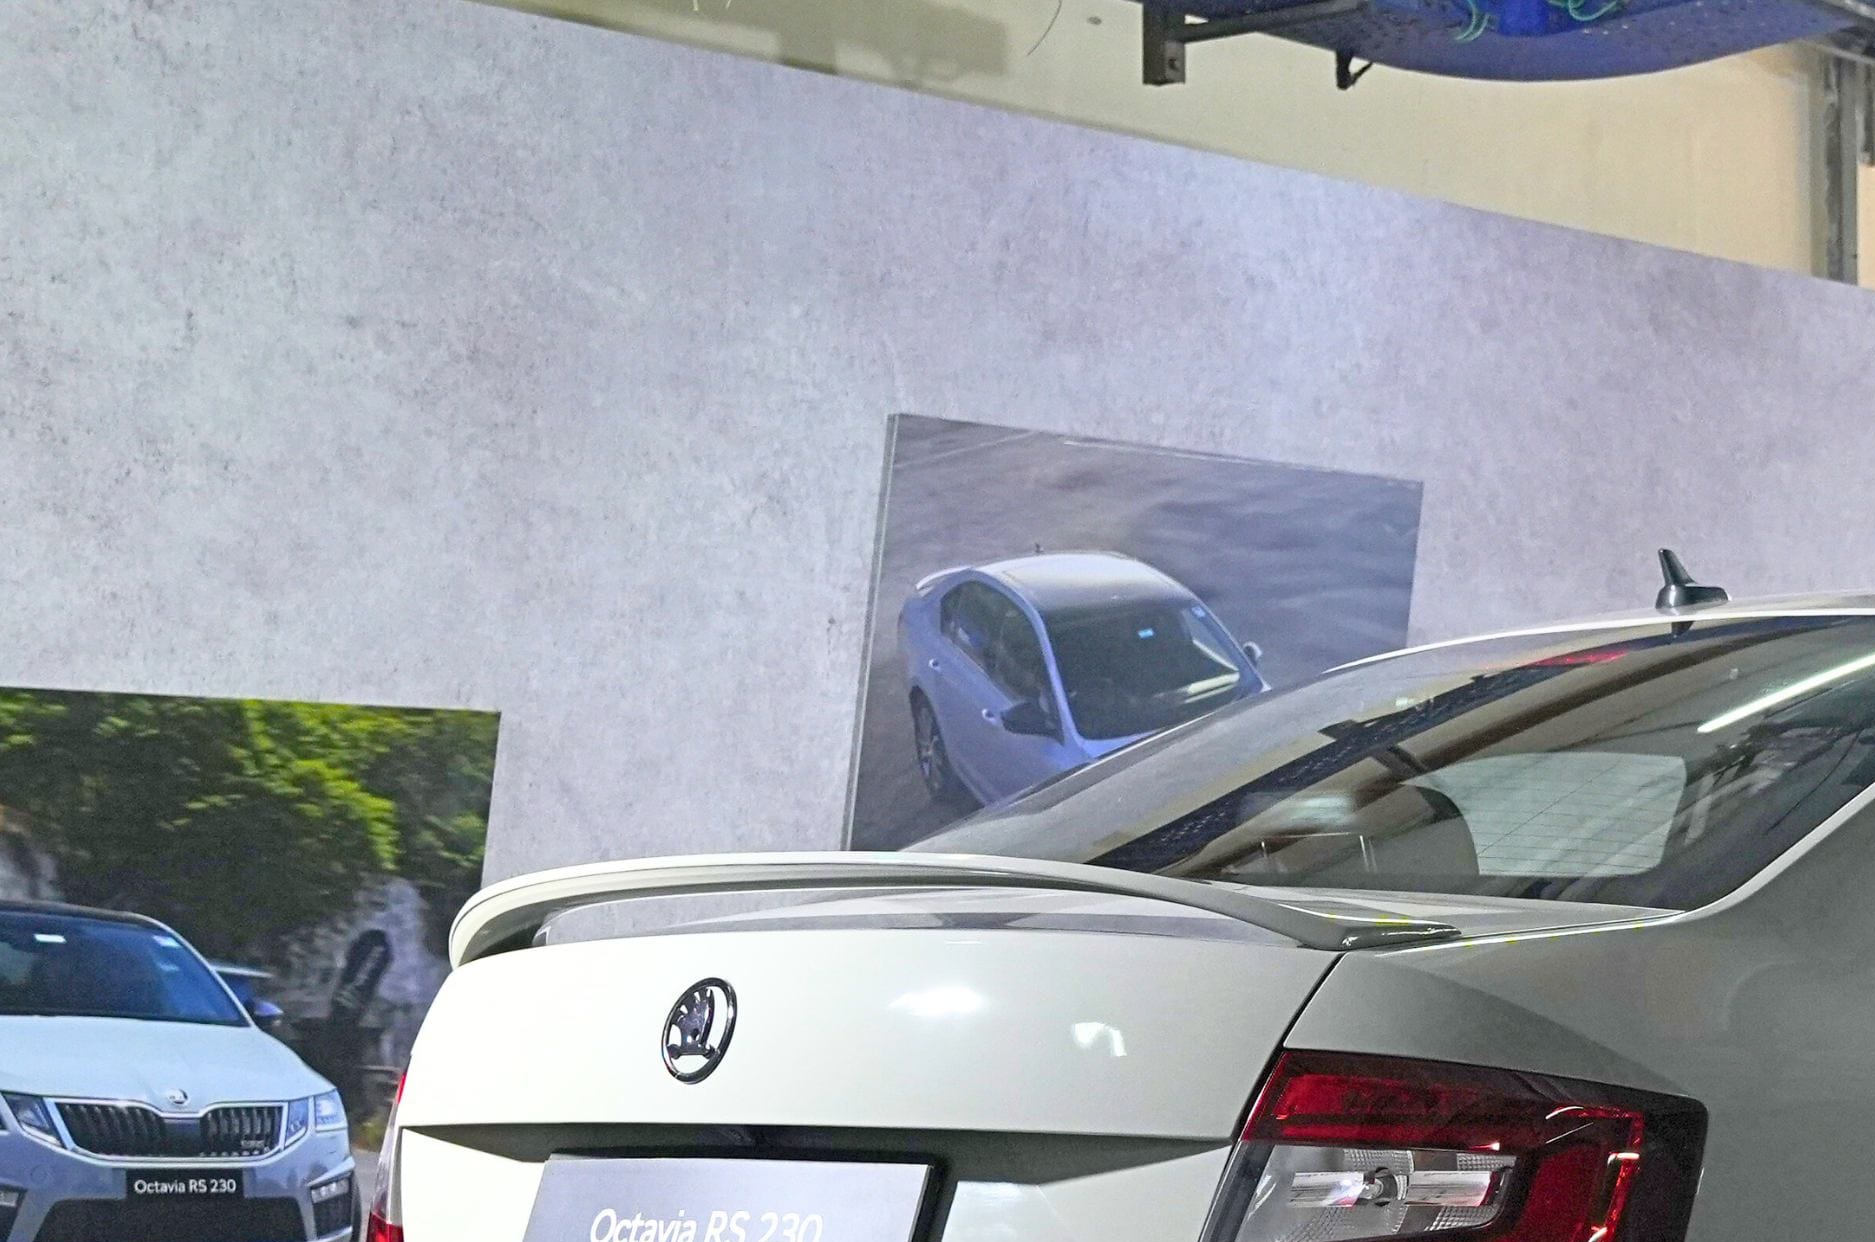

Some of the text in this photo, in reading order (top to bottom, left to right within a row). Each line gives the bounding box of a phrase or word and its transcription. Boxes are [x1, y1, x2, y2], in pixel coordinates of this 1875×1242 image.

[133, 1178, 236, 1195] Octavia RS 230
